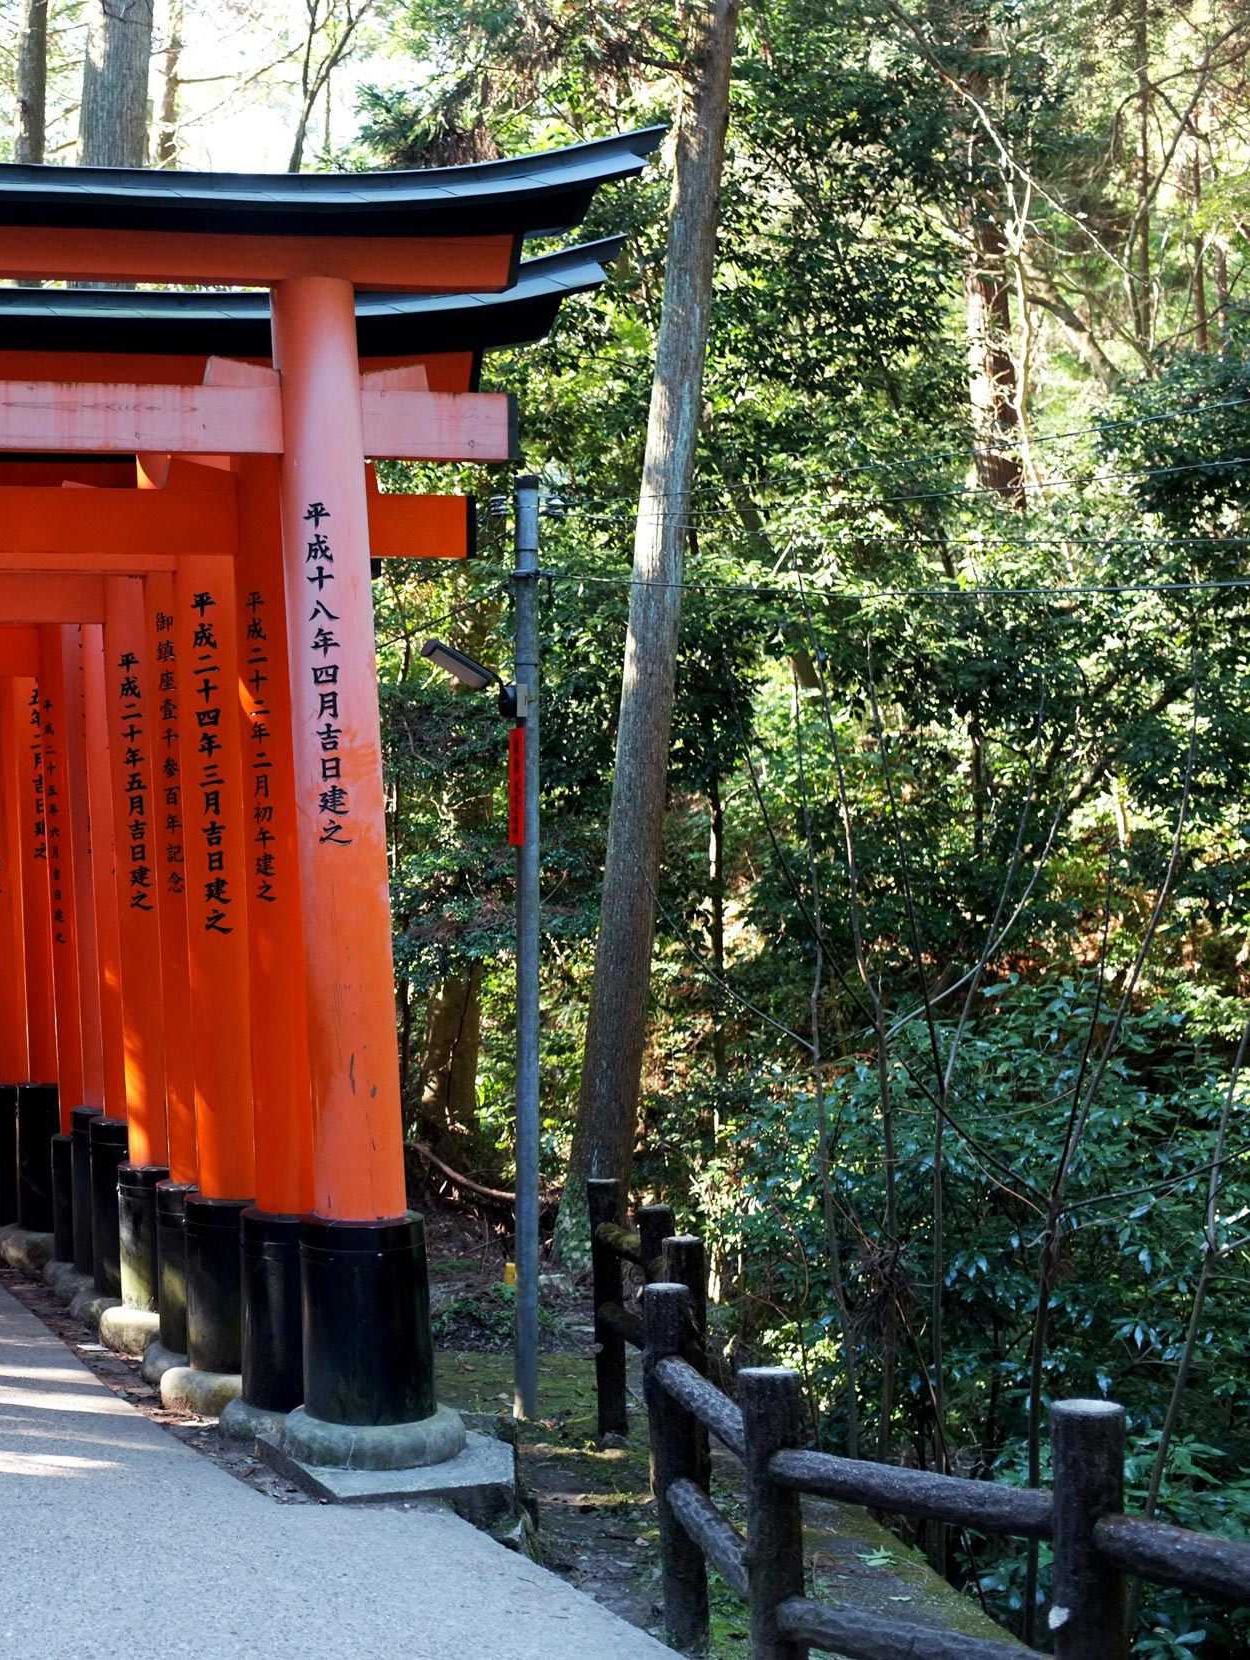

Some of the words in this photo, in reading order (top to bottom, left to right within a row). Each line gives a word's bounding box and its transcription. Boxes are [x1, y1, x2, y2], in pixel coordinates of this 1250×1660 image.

[43, 699, 65, 944] 平成二十五年六月吉日建之
[117, 652, 154, 912] 平成二十年五月吉日建之
[190, 591, 234, 935] 平成二十四年三月吉日建之
[245, 590, 277, 902] 平成二十二年二月初午建之
[302, 502, 352, 847] 平成十八年四月吉日建之
